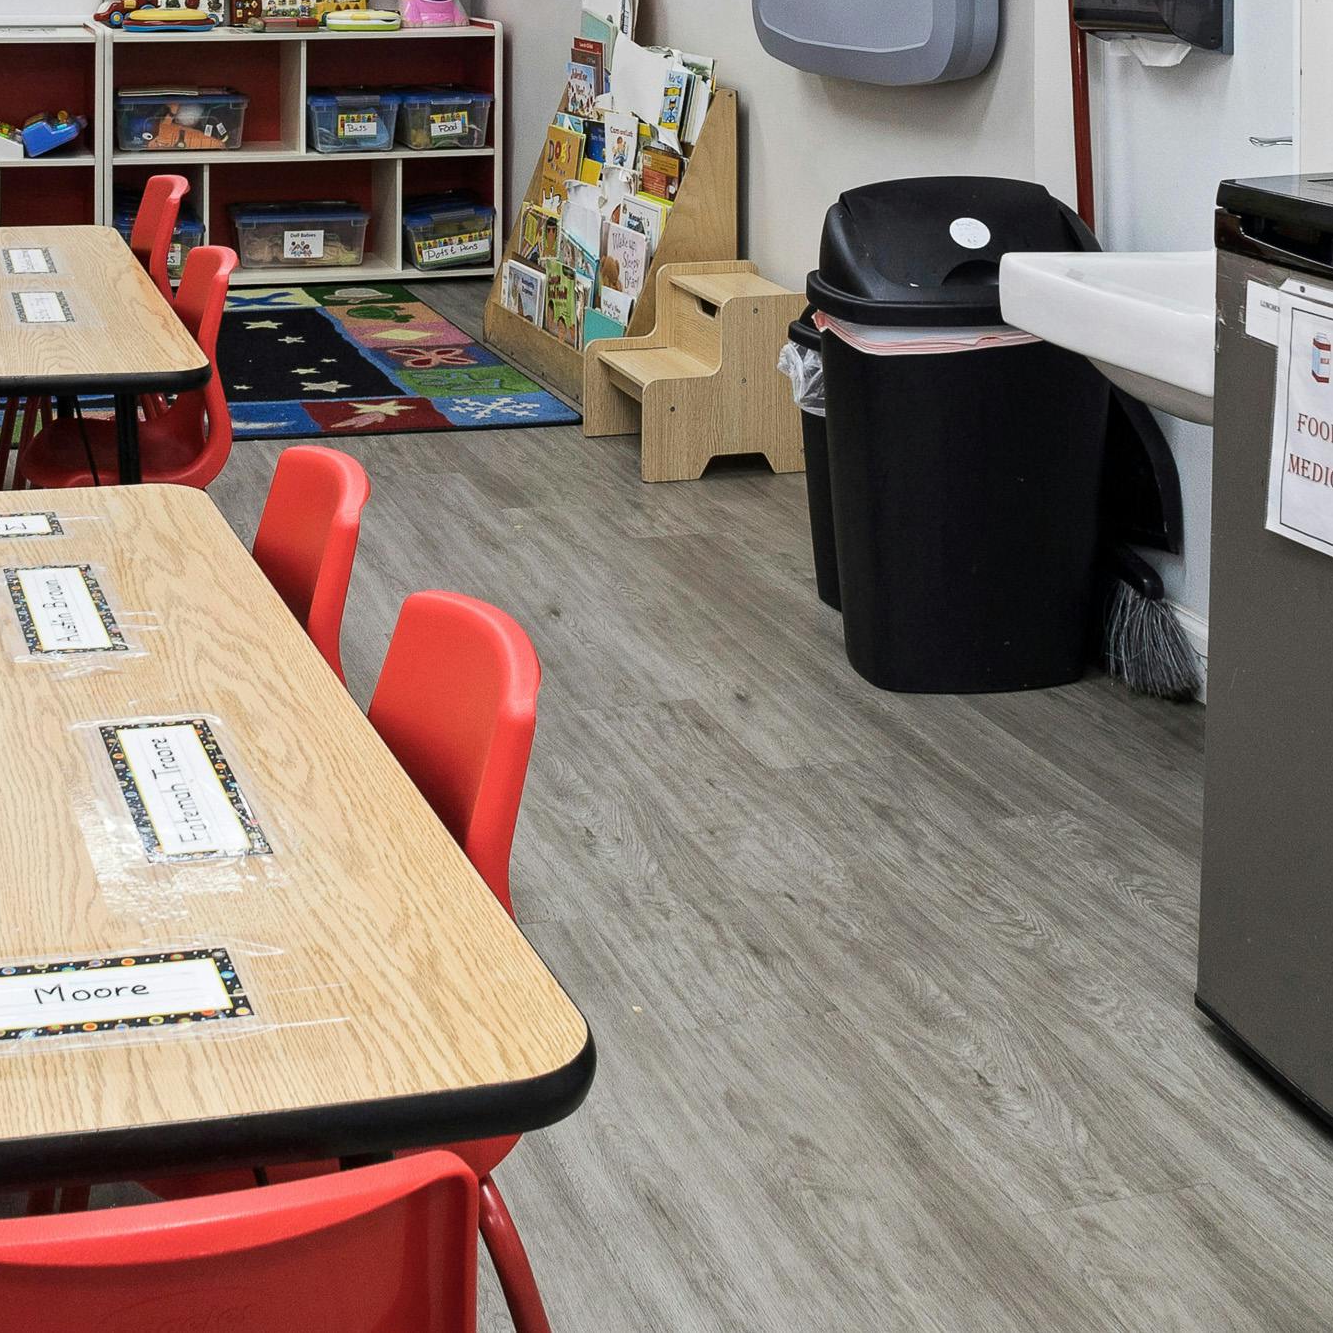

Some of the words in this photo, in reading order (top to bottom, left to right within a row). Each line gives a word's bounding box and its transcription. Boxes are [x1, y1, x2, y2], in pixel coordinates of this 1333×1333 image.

[438, 122, 458, 133] Food
[42, 579, 69, 610] Brown
[50, 611, 82, 643] Austin
[151, 737, 183, 780] Traore
[171, 782, 213, 845] Fatemah
[34, 983, 151, 1005] Moore
